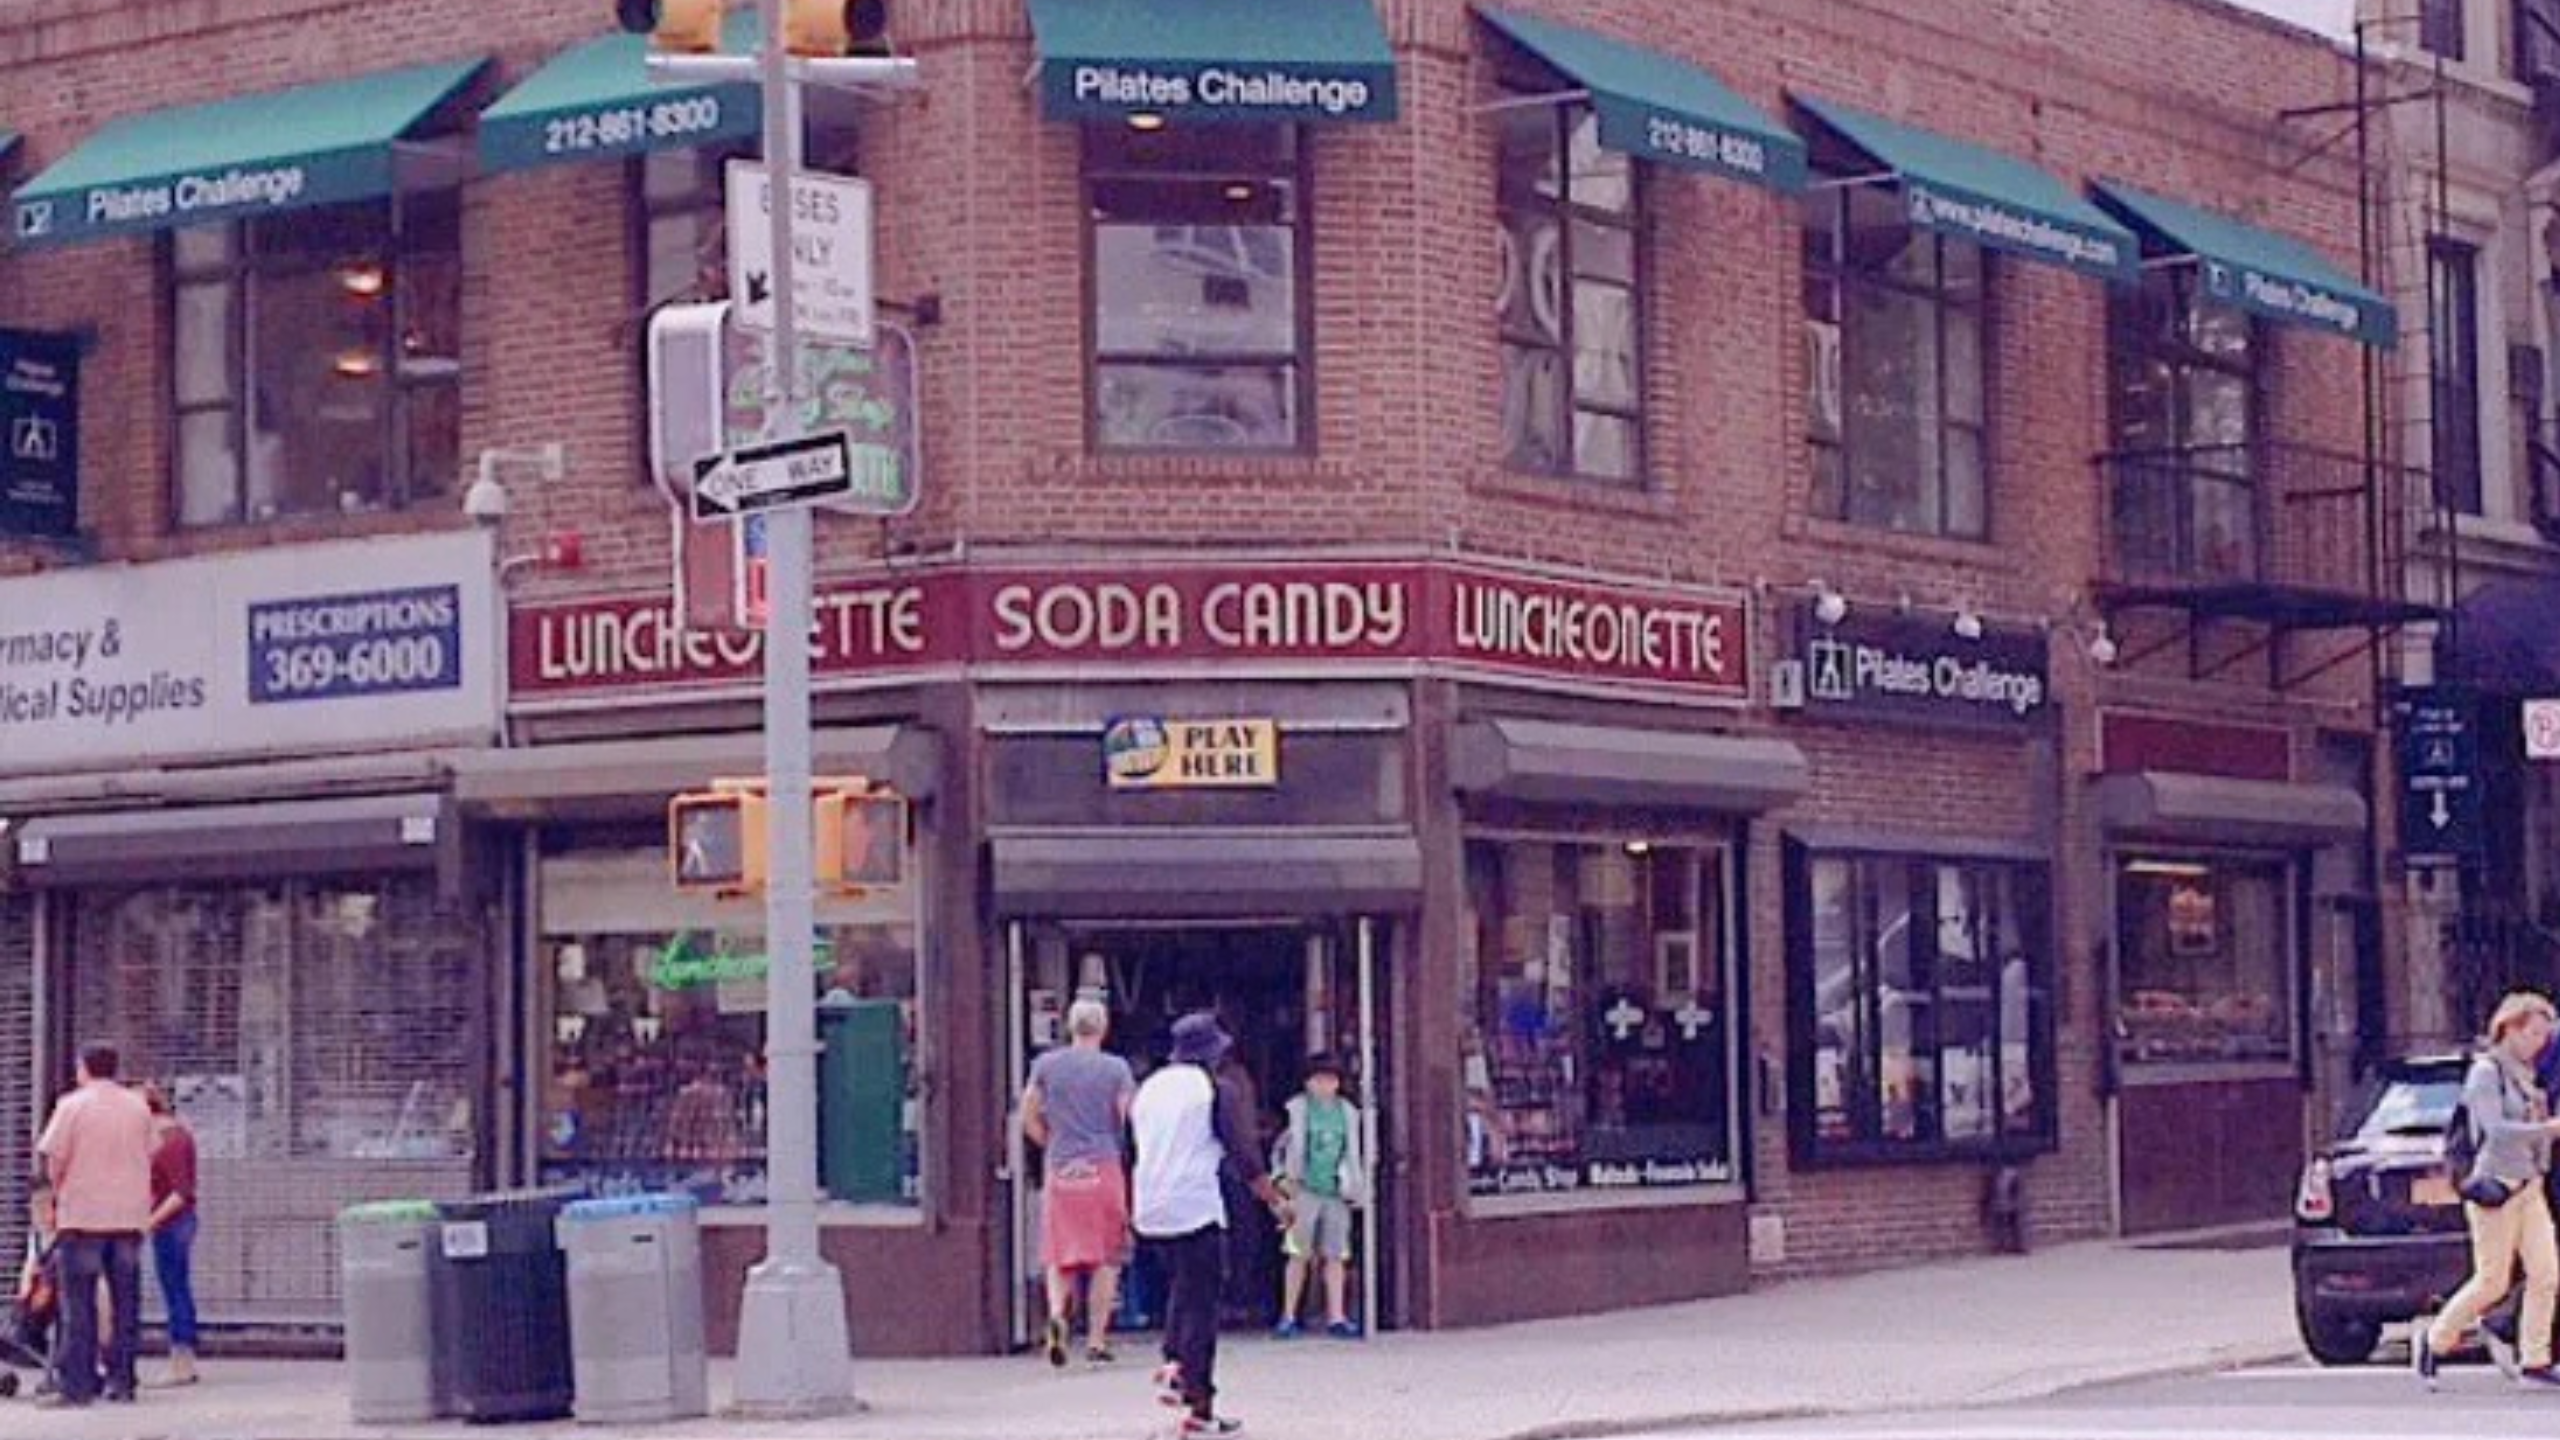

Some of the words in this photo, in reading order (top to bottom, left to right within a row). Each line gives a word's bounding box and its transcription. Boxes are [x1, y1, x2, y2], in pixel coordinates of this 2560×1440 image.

[1075, 67, 1191, 104] Pilates
[1198, 69, 1368, 113] Challenge
[87, 187, 171, 224] Pilates
[175, 168, 303, 209] Challenge
[709, 457, 760, 498] ONE
[787, 453, 835, 481] WAY
[100, 617, 121, 658] &
[254, 594, 452, 640] PRESCRIPTIONS
[540, 586, 925, 679] LUNCHEOTTE
[994, 583, 1180, 648] SODA
[1201, 581, 1404, 648] CANDY
[1456, 583, 1723, 674] LUNCHEONETTE
[265, 635, 442, 693] 369-6000
[1856, 644, 1931, 695] Pilates
[1933, 655, 2042, 714] Challenge
[67, 670, 207, 726] Supplies
[1184, 725, 1258, 749] PLAY
[1180, 754, 1261, 777] HERE
